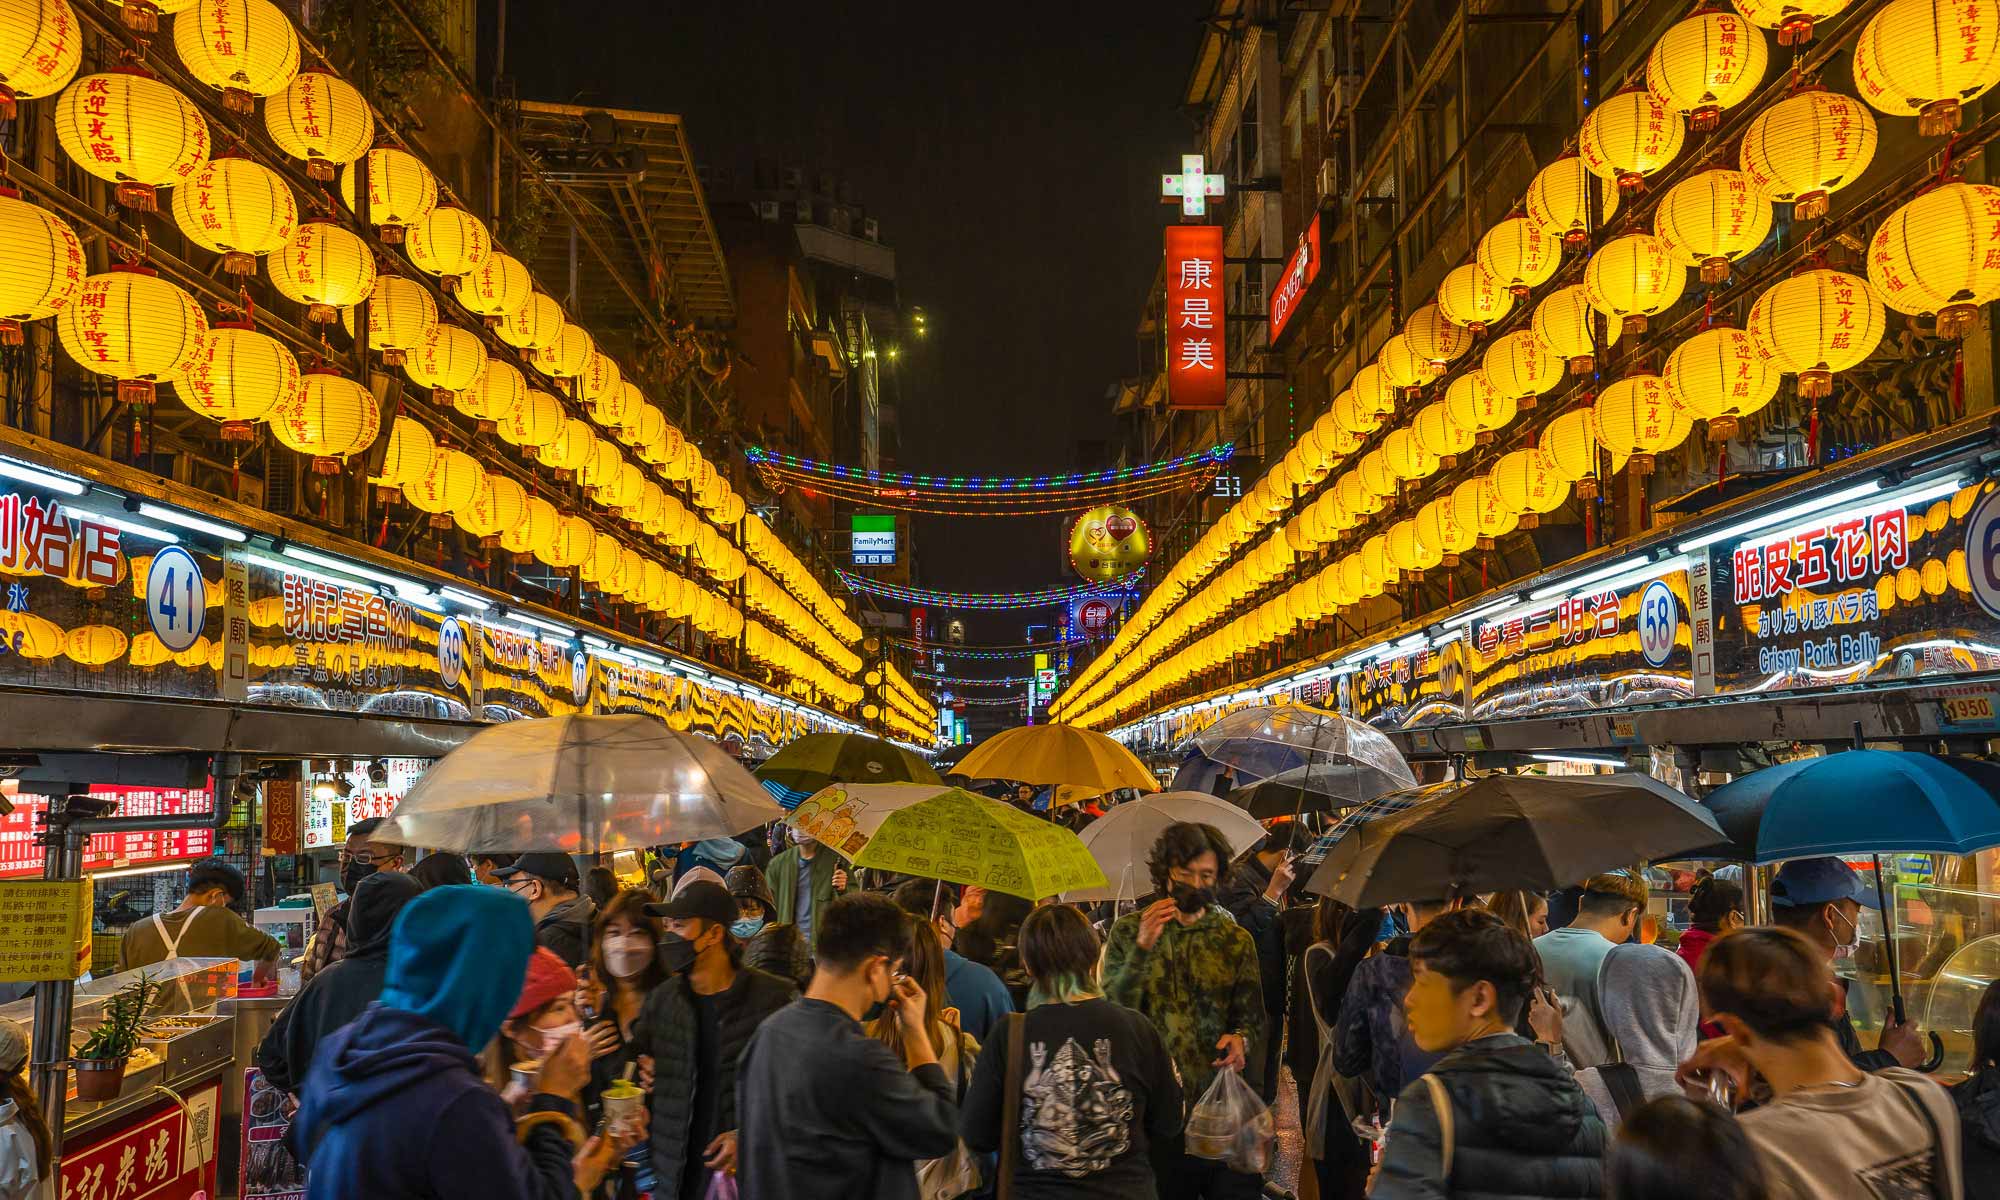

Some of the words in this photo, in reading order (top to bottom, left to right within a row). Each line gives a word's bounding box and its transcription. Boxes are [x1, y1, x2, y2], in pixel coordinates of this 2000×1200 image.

[1179, 257, 1213, 370] 康是美
[1830, 275, 1856, 350] 歡迎光臨
[853, 536, 895, 548] FamilyMart
[1733, 505, 1909, 604] 脆皮五花肉
[159, 566, 194, 634] 41
[1478, 590, 1621, 661] 營養三明治
[1645, 596, 1670, 652] 58
[1757, 589, 1880, 638] カリカリ豚バラ肉
[443, 628, 461, 673] 39
[1759, 646, 1800, 676] Crispy
[1803, 637, 1837, 668] Pork
[1841, 631, 1880, 667] Belly
